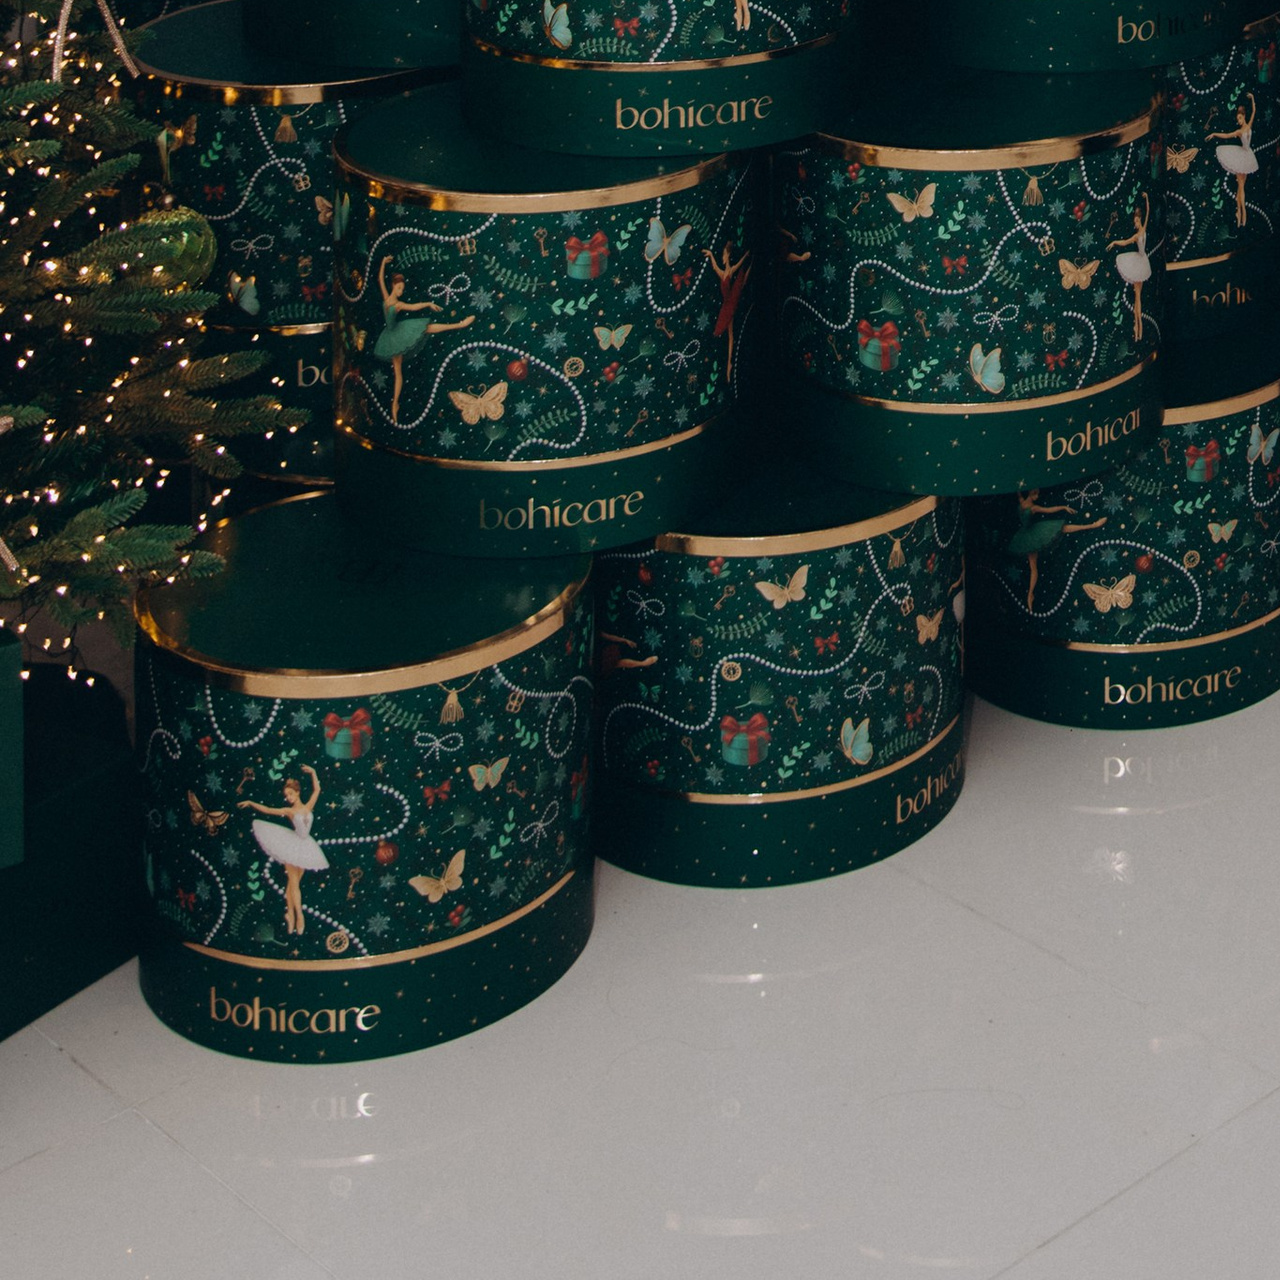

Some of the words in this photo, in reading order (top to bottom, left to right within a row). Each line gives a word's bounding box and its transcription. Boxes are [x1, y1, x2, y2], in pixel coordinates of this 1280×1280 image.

[616, 95, 774, 130] bohicare
[479, 490, 645, 531] bohicare
[1103, 665, 1243, 705] bohicare
[210, 985, 382, 1034] bohicare
